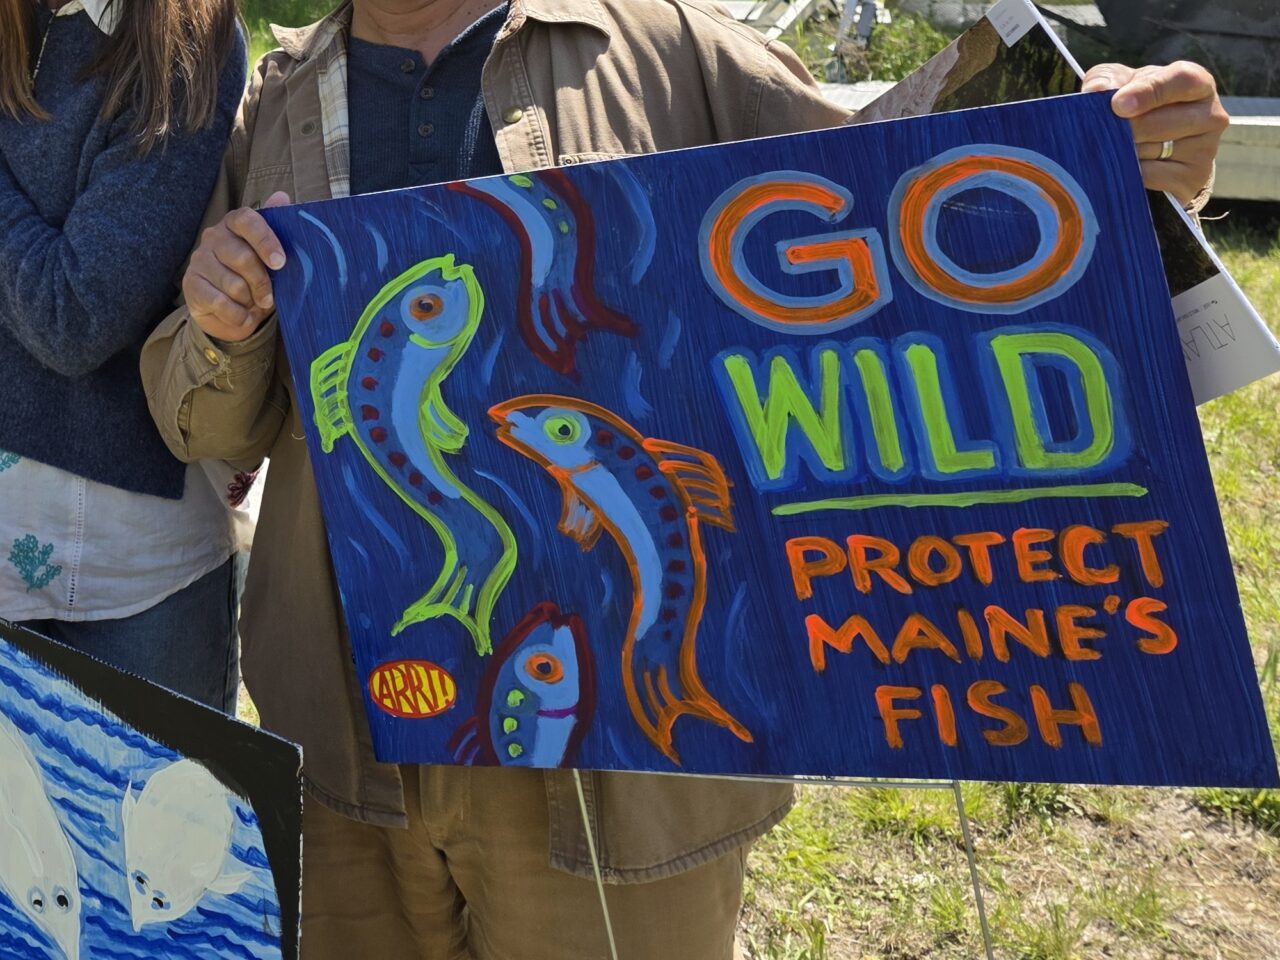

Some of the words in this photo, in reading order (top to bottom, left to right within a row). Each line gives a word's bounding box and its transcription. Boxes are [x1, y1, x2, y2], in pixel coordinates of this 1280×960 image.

[700, 144, 1100, 334] GO
[712, 326, 1130, 490] WILD
[785, 520, 1170, 601] PROTECT
[806, 596, 1179, 671] MAINE'S
[875, 681, 1103, 749] FISH
